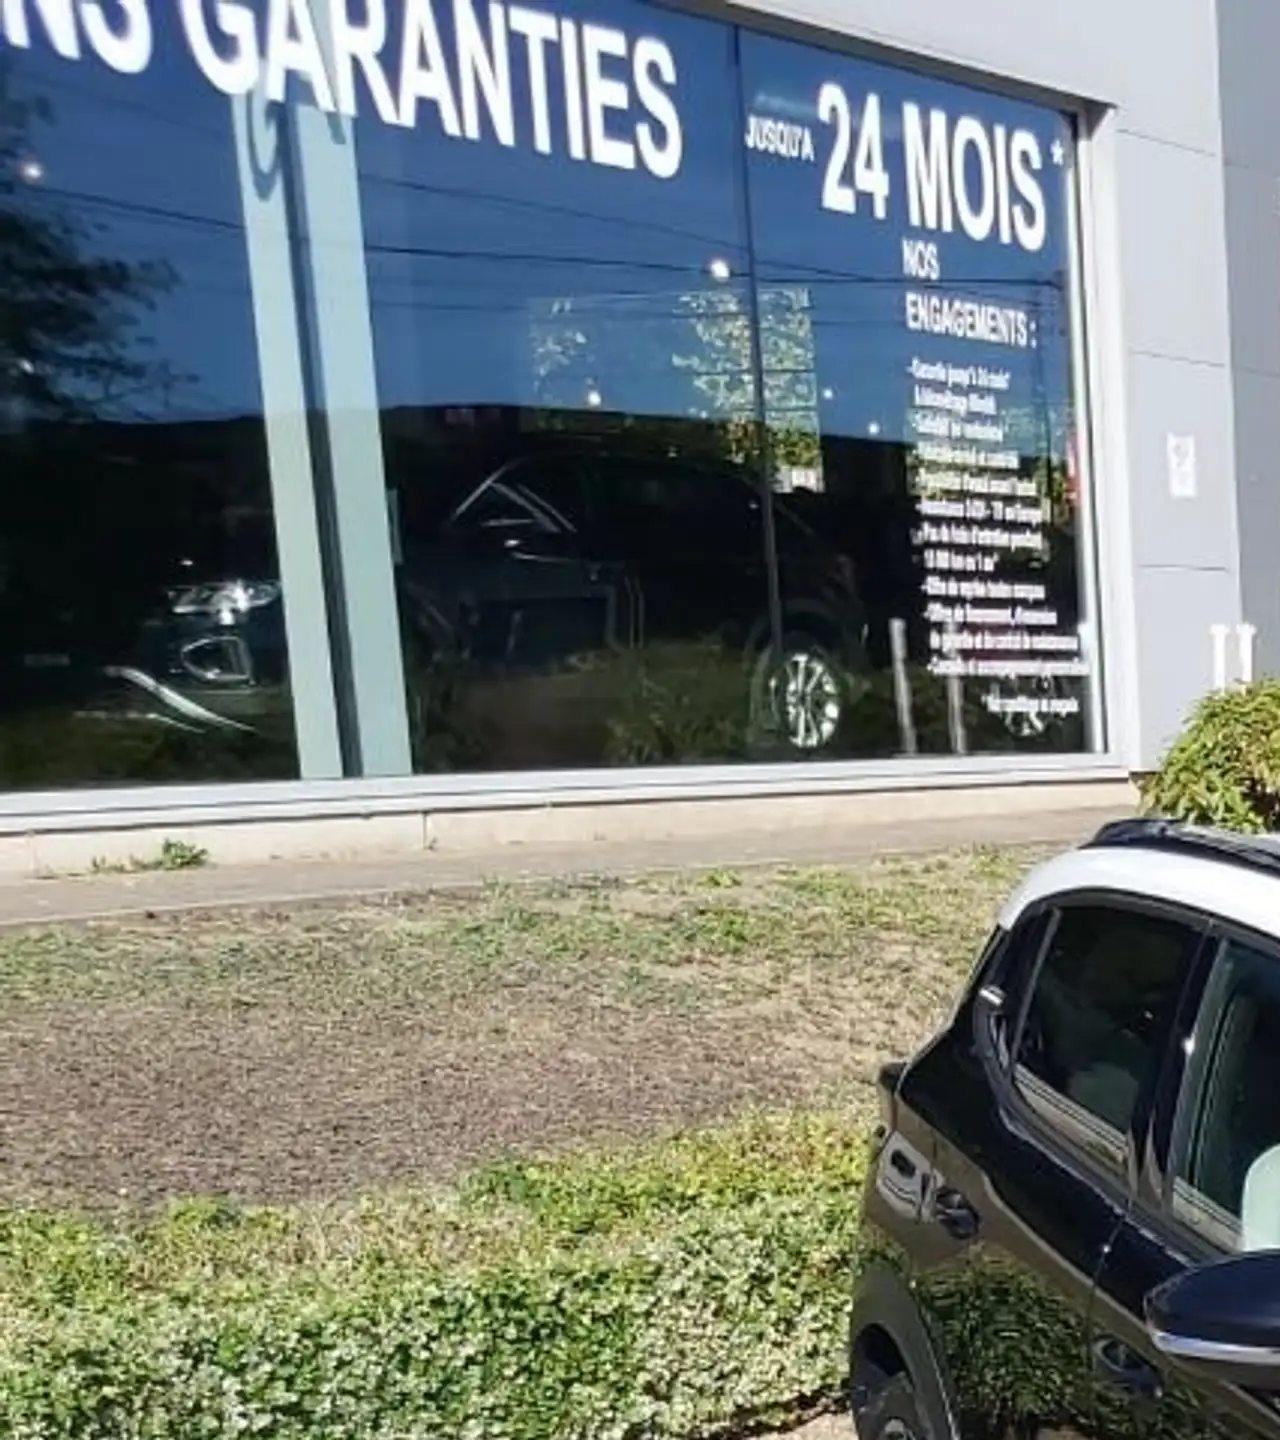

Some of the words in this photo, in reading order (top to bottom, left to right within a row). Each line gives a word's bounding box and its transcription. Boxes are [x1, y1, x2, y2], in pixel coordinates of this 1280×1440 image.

[178, 0, 683, 179] GARANTIES
[818, 82, 890, 221] 24
[902, 239, 940, 281] NOS
